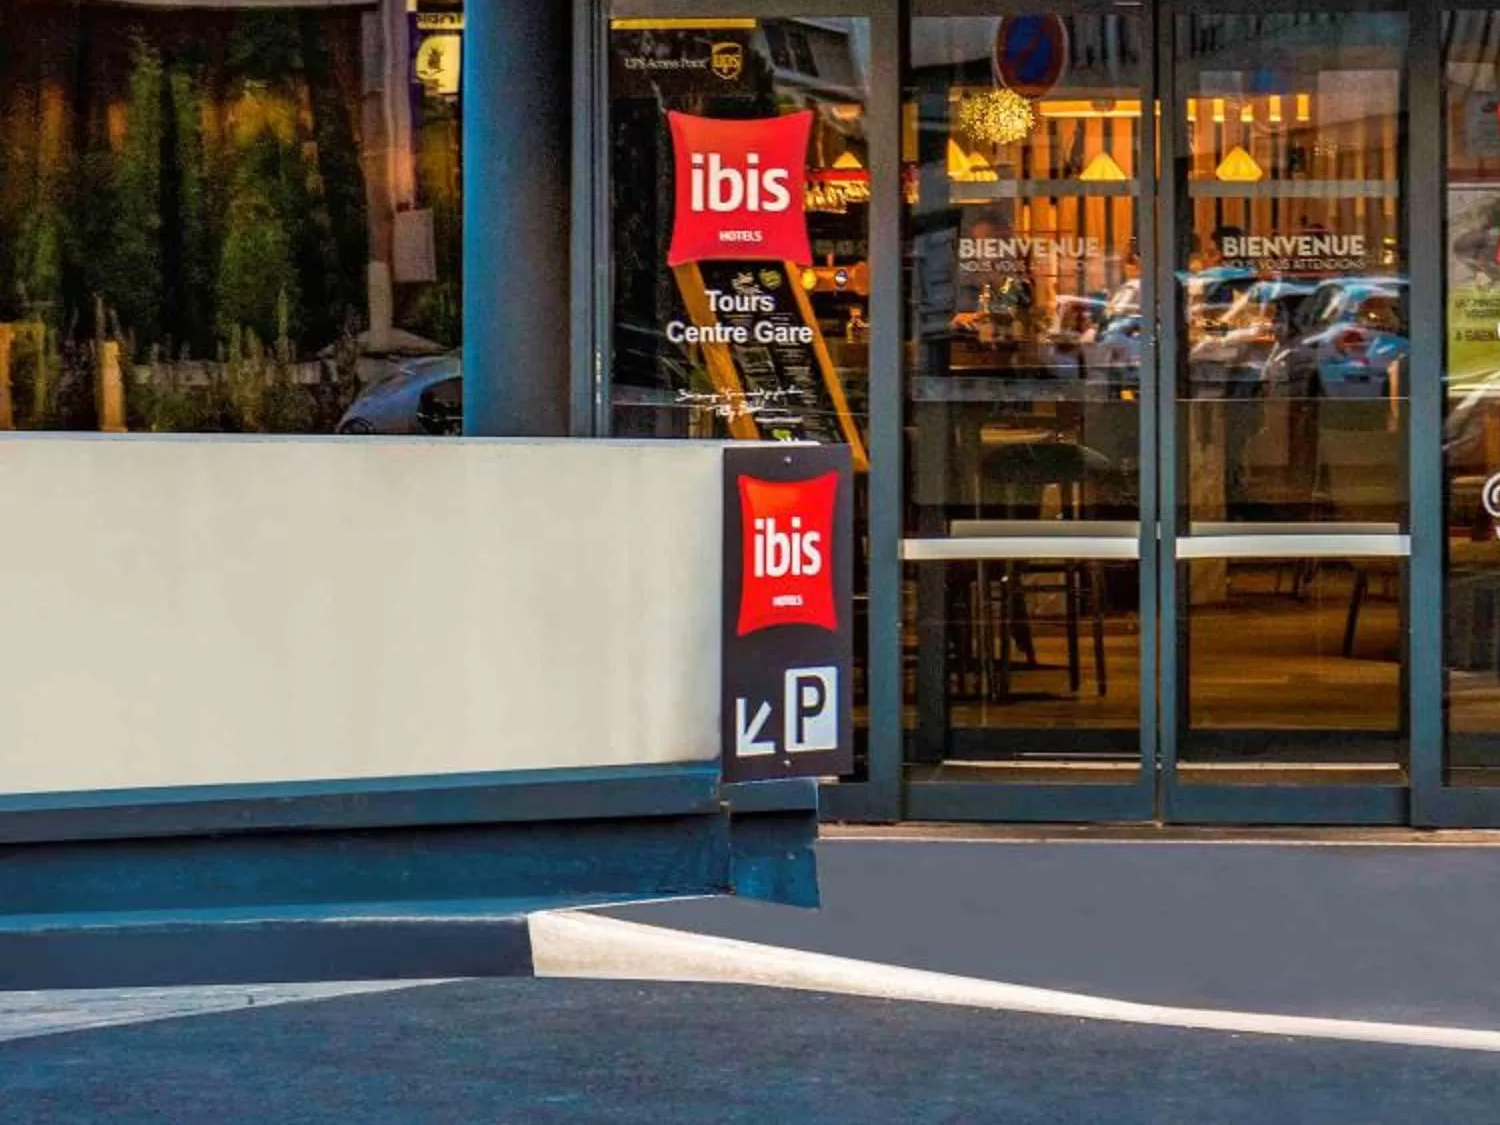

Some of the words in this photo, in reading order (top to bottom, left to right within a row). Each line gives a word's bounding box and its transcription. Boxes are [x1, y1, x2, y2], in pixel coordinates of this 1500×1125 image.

[691, 153, 791, 213] ibis
[719, 230, 763, 242] HOTELS
[1222, 235, 1366, 258] BIENVENUE
[958, 237, 1100, 259] BIENVENUE
[705, 289, 775, 312] Tours
[666, 320, 748, 344] Centre
[754, 320, 814, 344] Gare
[754, 517, 823, 578] ibis
[795, 674, 827, 745] P
